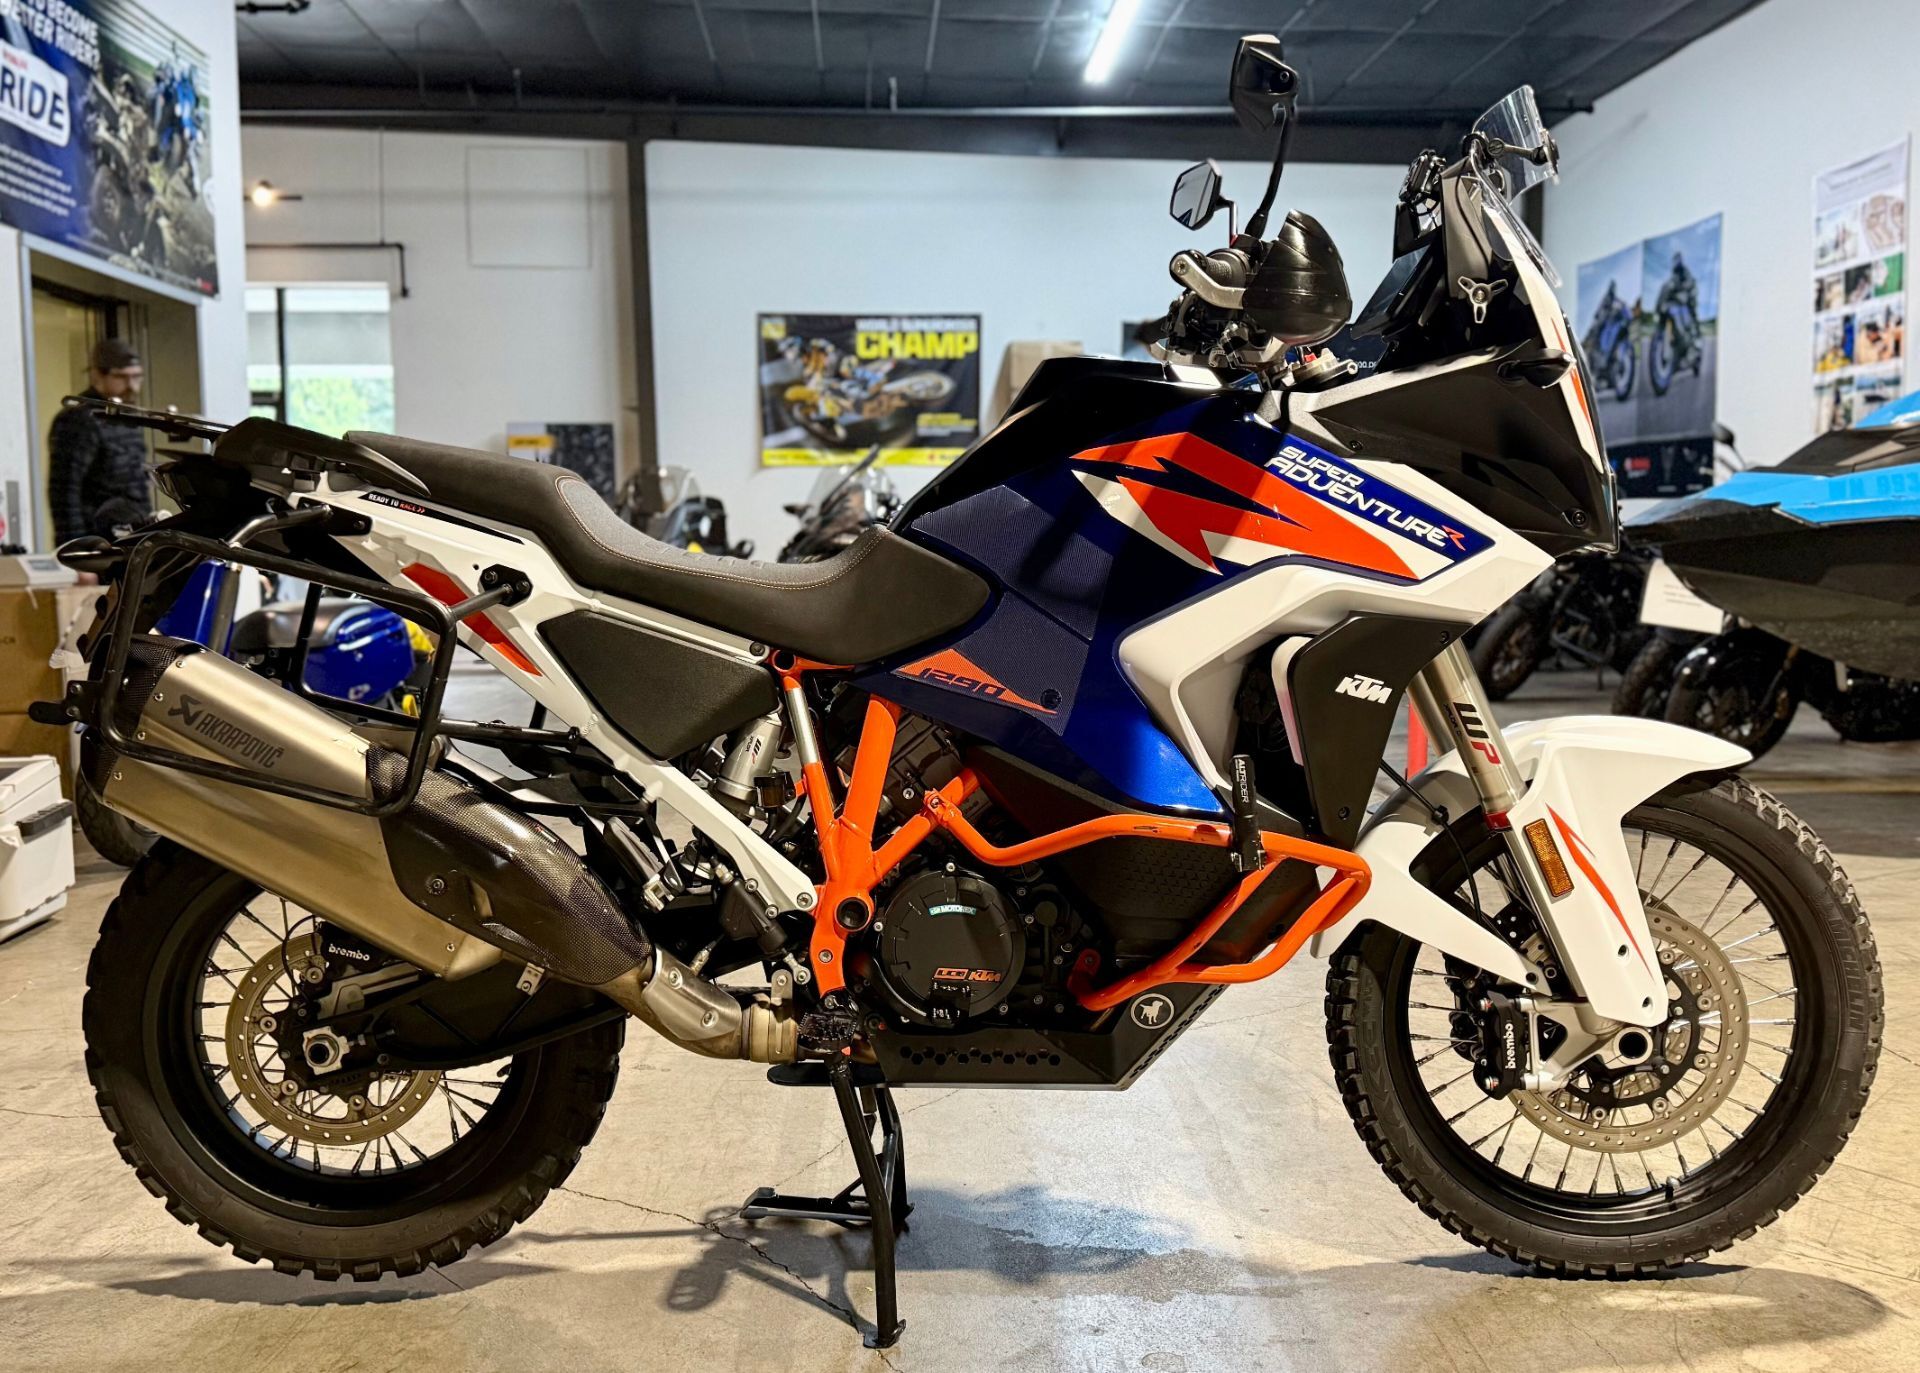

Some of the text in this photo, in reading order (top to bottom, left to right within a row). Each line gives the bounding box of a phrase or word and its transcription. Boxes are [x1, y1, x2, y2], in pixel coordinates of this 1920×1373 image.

[0, 64, 64, 131] RIDE
[856, 331, 978, 360] CHAMP
[1279, 445, 1365, 488] SUPER
[368, 493, 389, 505] READY
[390, 498, 400, 507] TO
[1263, 456, 1449, 548] ADVENTURE
[918, 667, 1007, 699] 1290
[1335, 674, 1393, 704] KTM
[1452, 702, 1502, 765] WP
[1238, 758, 1250, 803] ALTRIDER
[940, 904, 977, 916] MOTOREX
[328, 943, 371, 962] brembo
[968, 969, 1002, 982] KTM
[1503, 1022, 1517, 1069] brembo
